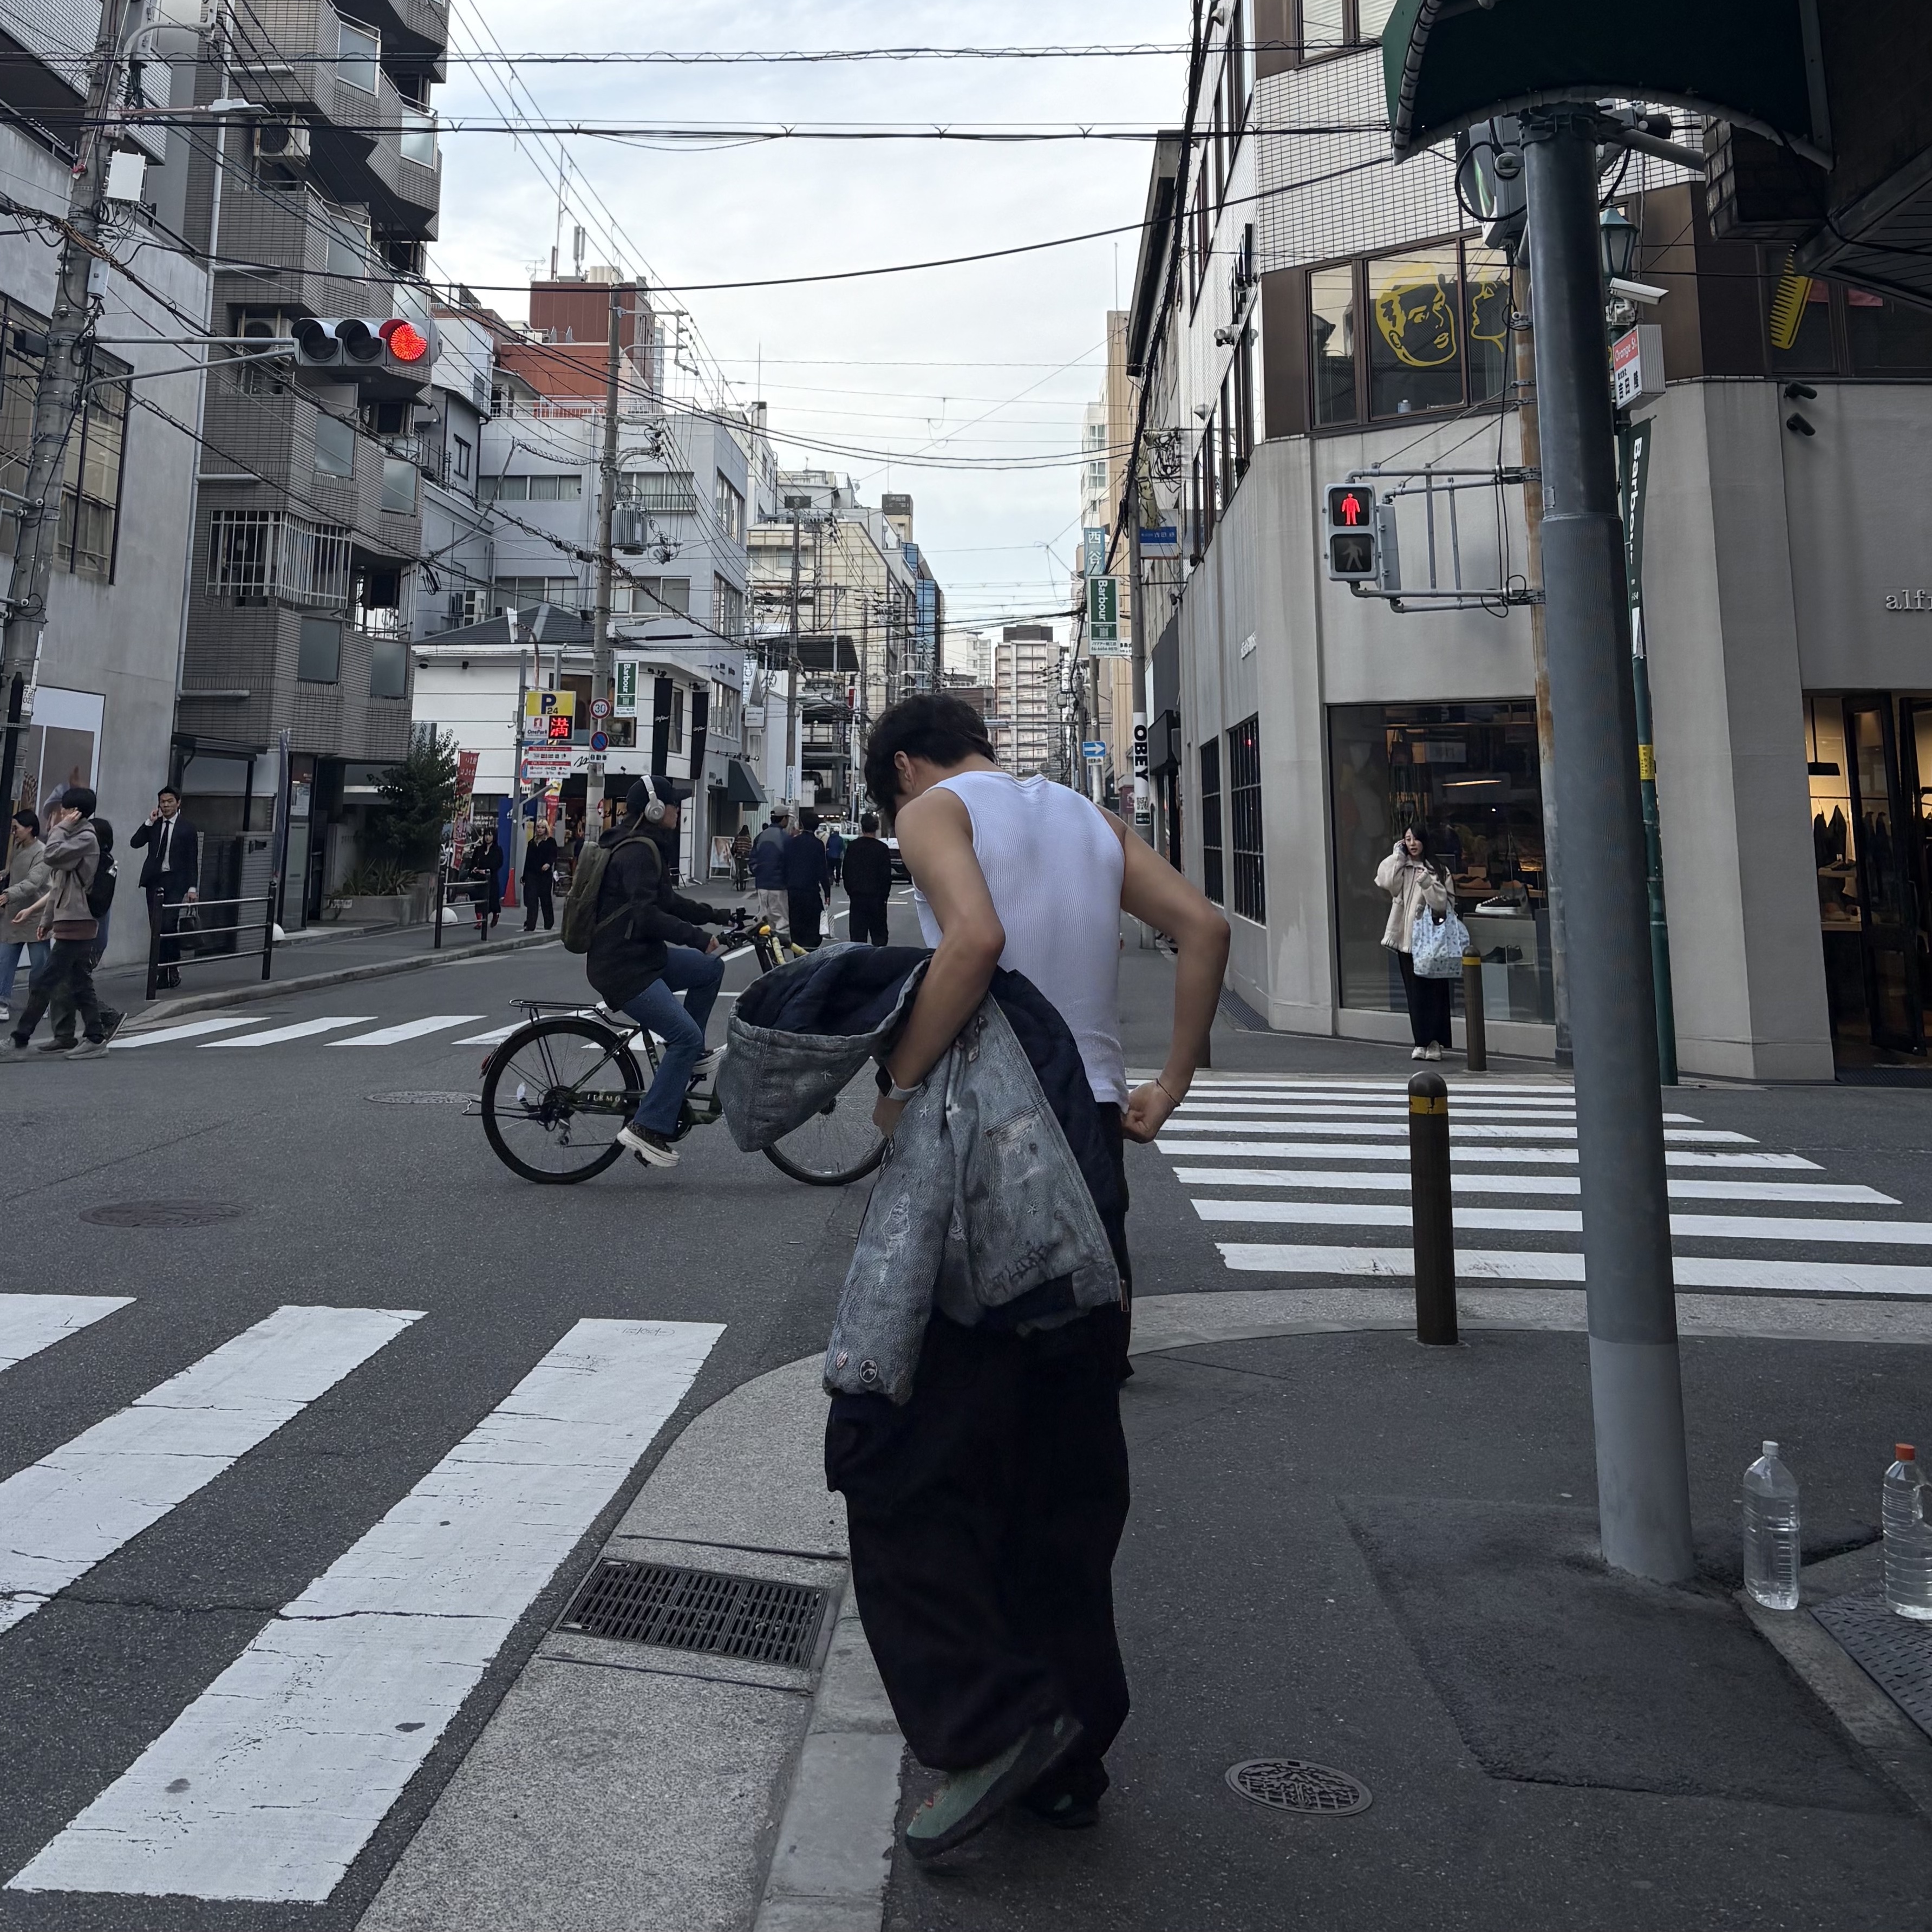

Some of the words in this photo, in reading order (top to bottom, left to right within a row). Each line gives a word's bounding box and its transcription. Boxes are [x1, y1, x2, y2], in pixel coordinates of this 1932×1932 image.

[1615, 344, 1631, 362] Orange
[1088, 531, 1102, 565] 西谷
[1098, 579, 1108, 621] Barbour
[623, 663, 631, 693] Barbour
[541, 694, 557, 715] P
[595, 704, 606, 713] 30
[550, 717, 569, 737] 満
[1134, 724, 1148, 783] OBEY
